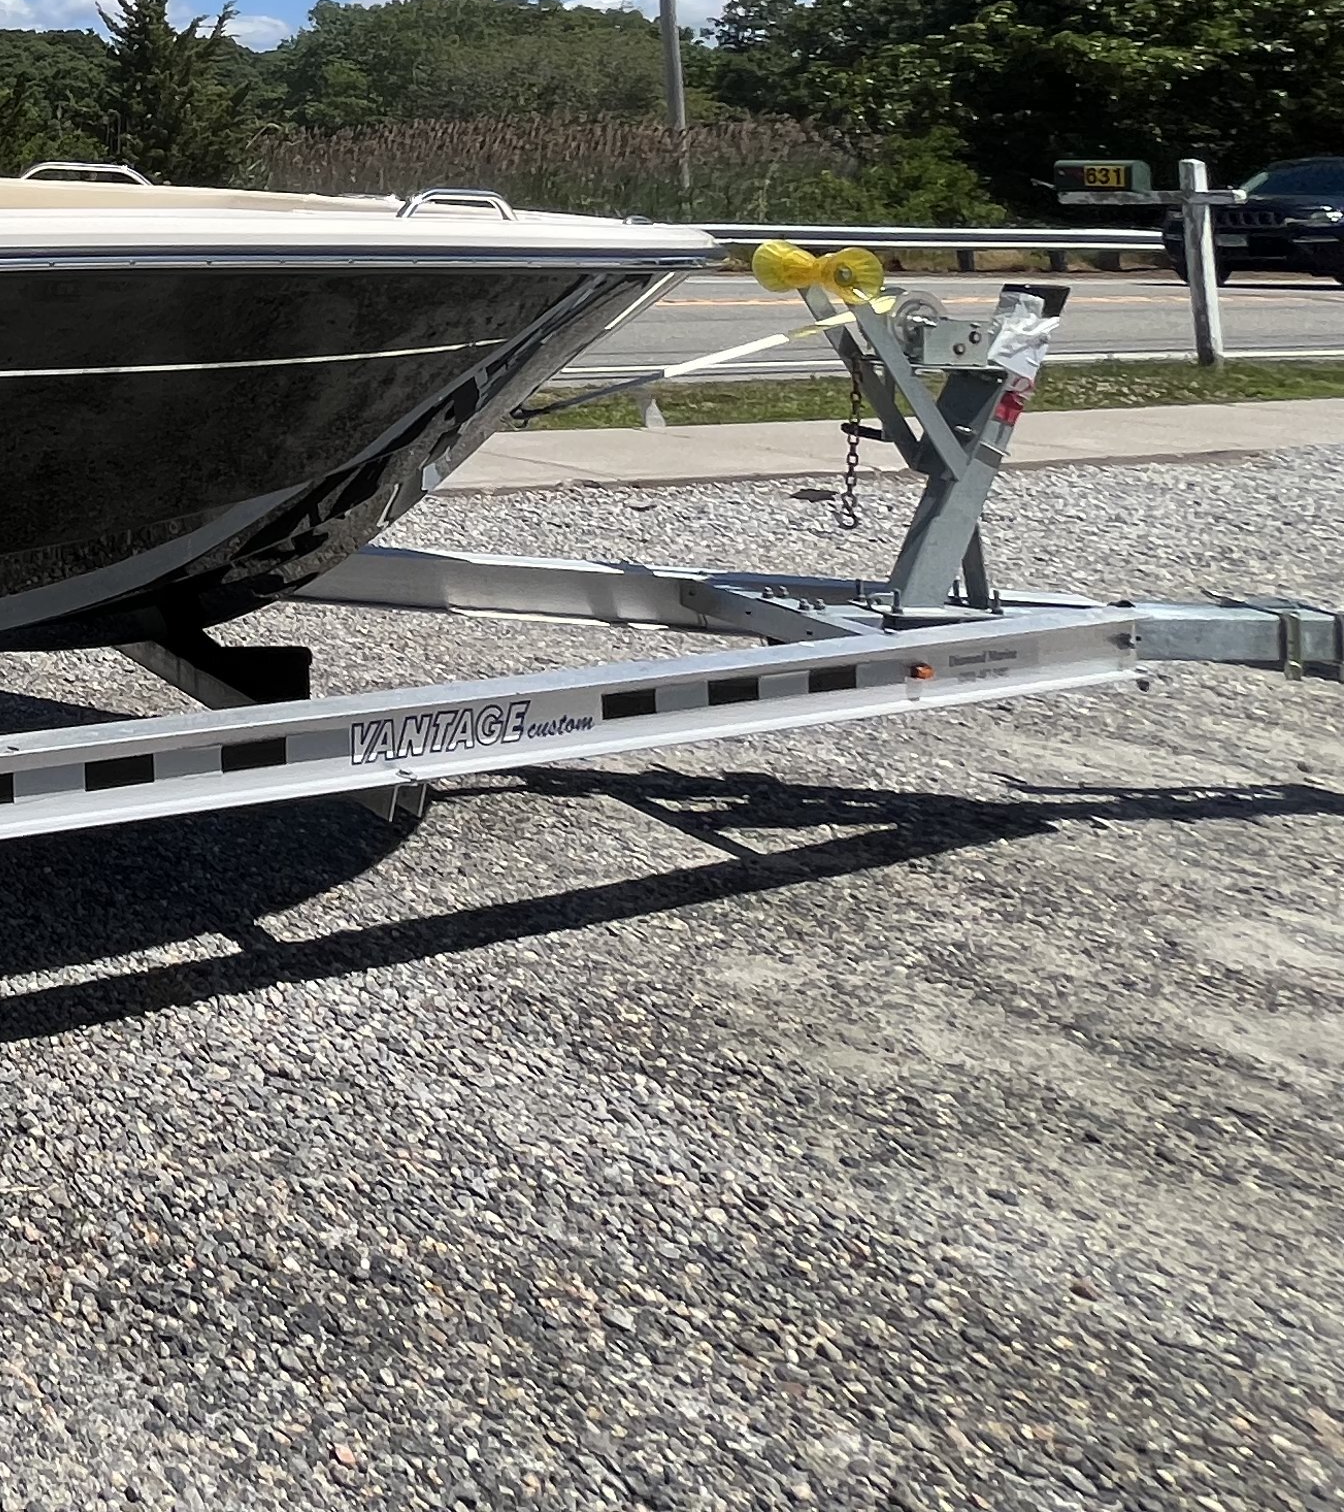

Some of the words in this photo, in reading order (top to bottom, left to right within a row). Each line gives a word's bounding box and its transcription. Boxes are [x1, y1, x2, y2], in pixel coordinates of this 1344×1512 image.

[1086, 168, 1121, 185] 631
[350, 700, 531, 765] VANTAGE
[527, 714, 594, 739] custom
